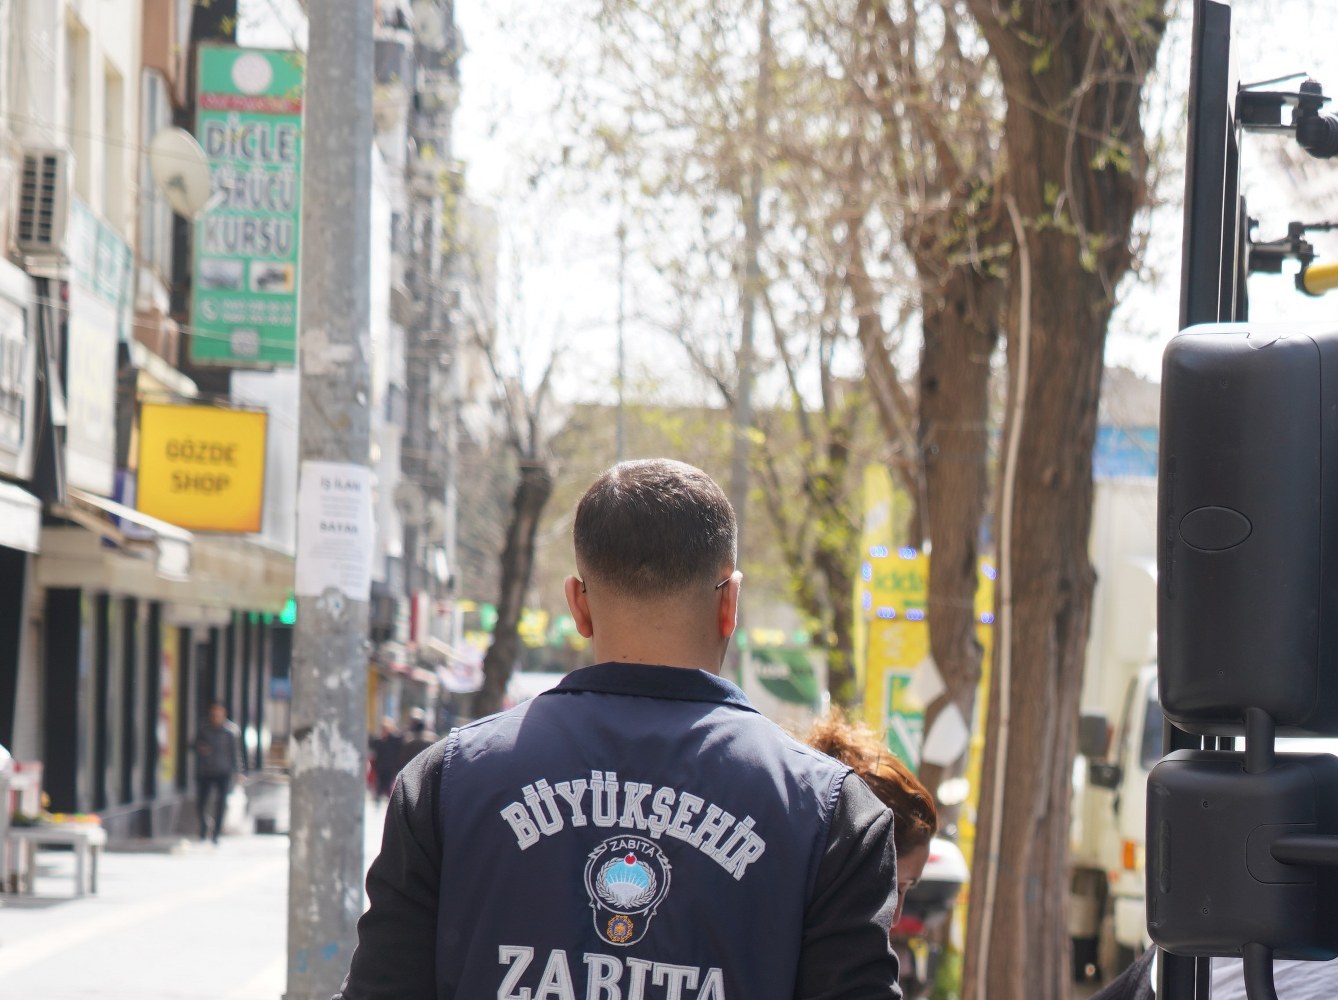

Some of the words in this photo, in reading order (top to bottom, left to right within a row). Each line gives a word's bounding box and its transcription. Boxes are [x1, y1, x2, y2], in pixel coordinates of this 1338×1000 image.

[202, 215, 294, 257] KURSU
[171, 471, 231, 495] SHOP
[500, 769, 766, 882] BÜYÜKŞEHİR
[609, 839, 656, 858] ZABITA
